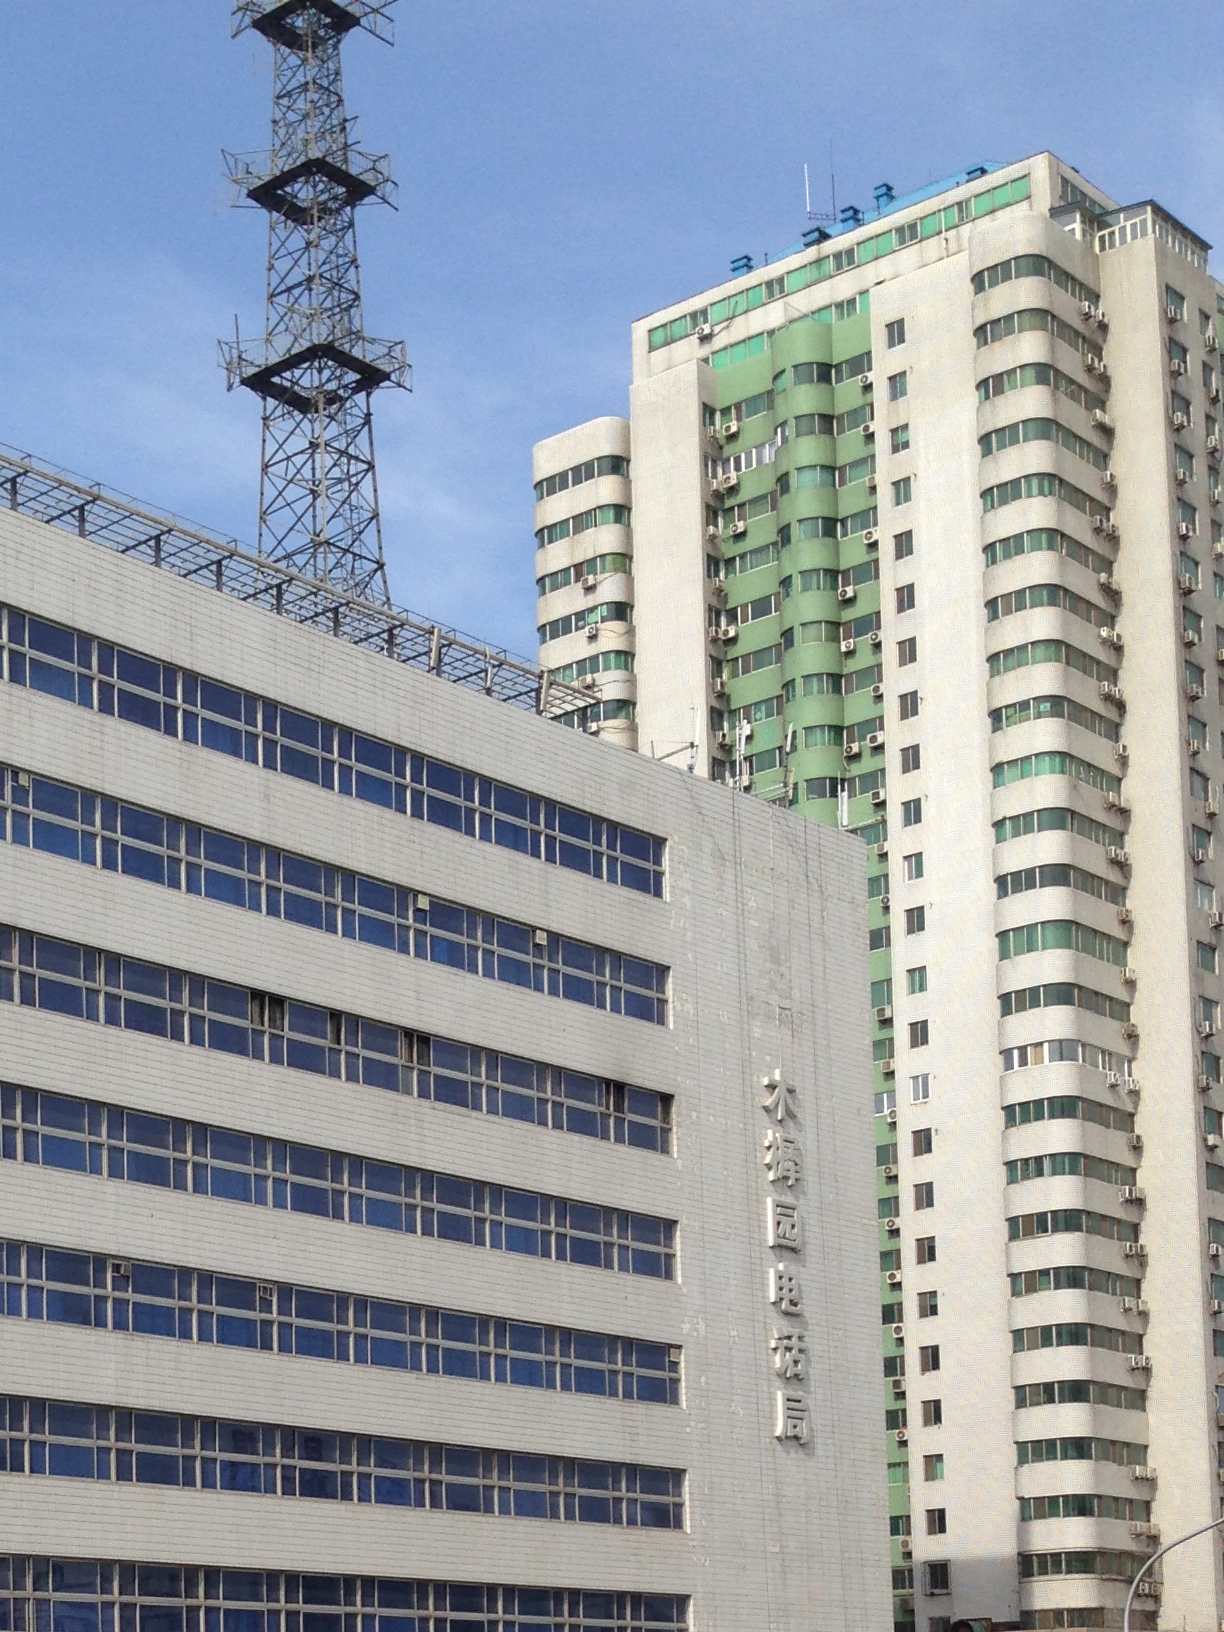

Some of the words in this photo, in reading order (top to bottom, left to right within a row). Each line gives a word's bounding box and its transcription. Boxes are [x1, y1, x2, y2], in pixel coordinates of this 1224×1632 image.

[762, 1068, 808, 1445] 木樨园电话局
